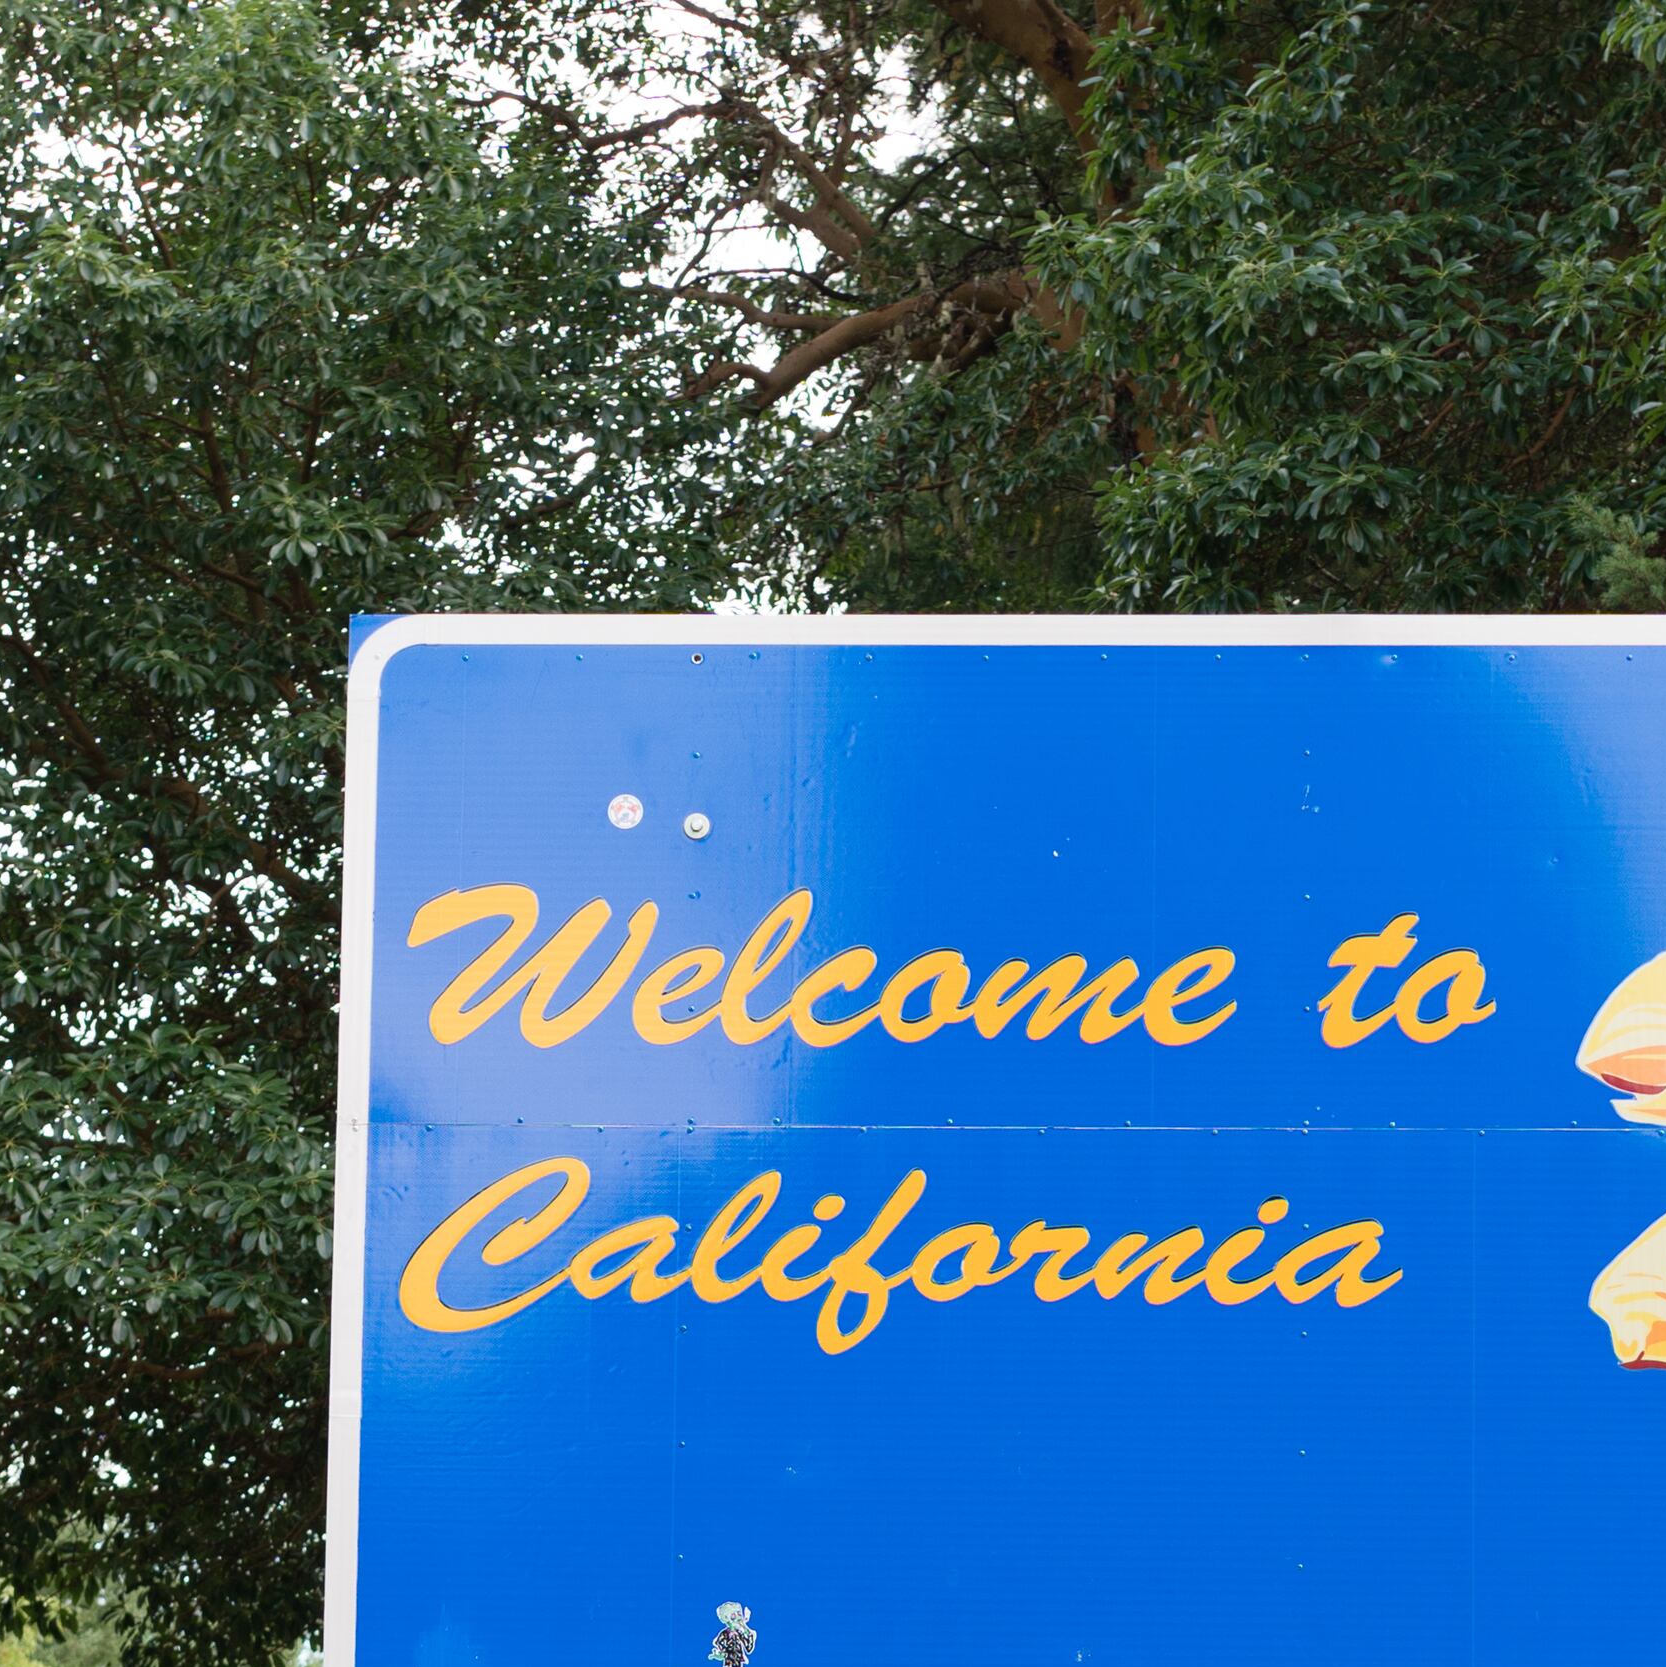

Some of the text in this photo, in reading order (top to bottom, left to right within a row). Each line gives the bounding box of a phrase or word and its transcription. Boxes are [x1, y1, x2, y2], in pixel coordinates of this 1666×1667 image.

[407, 883, 1497, 1049] Welcome to
[398, 1156, 1404, 1356] California
